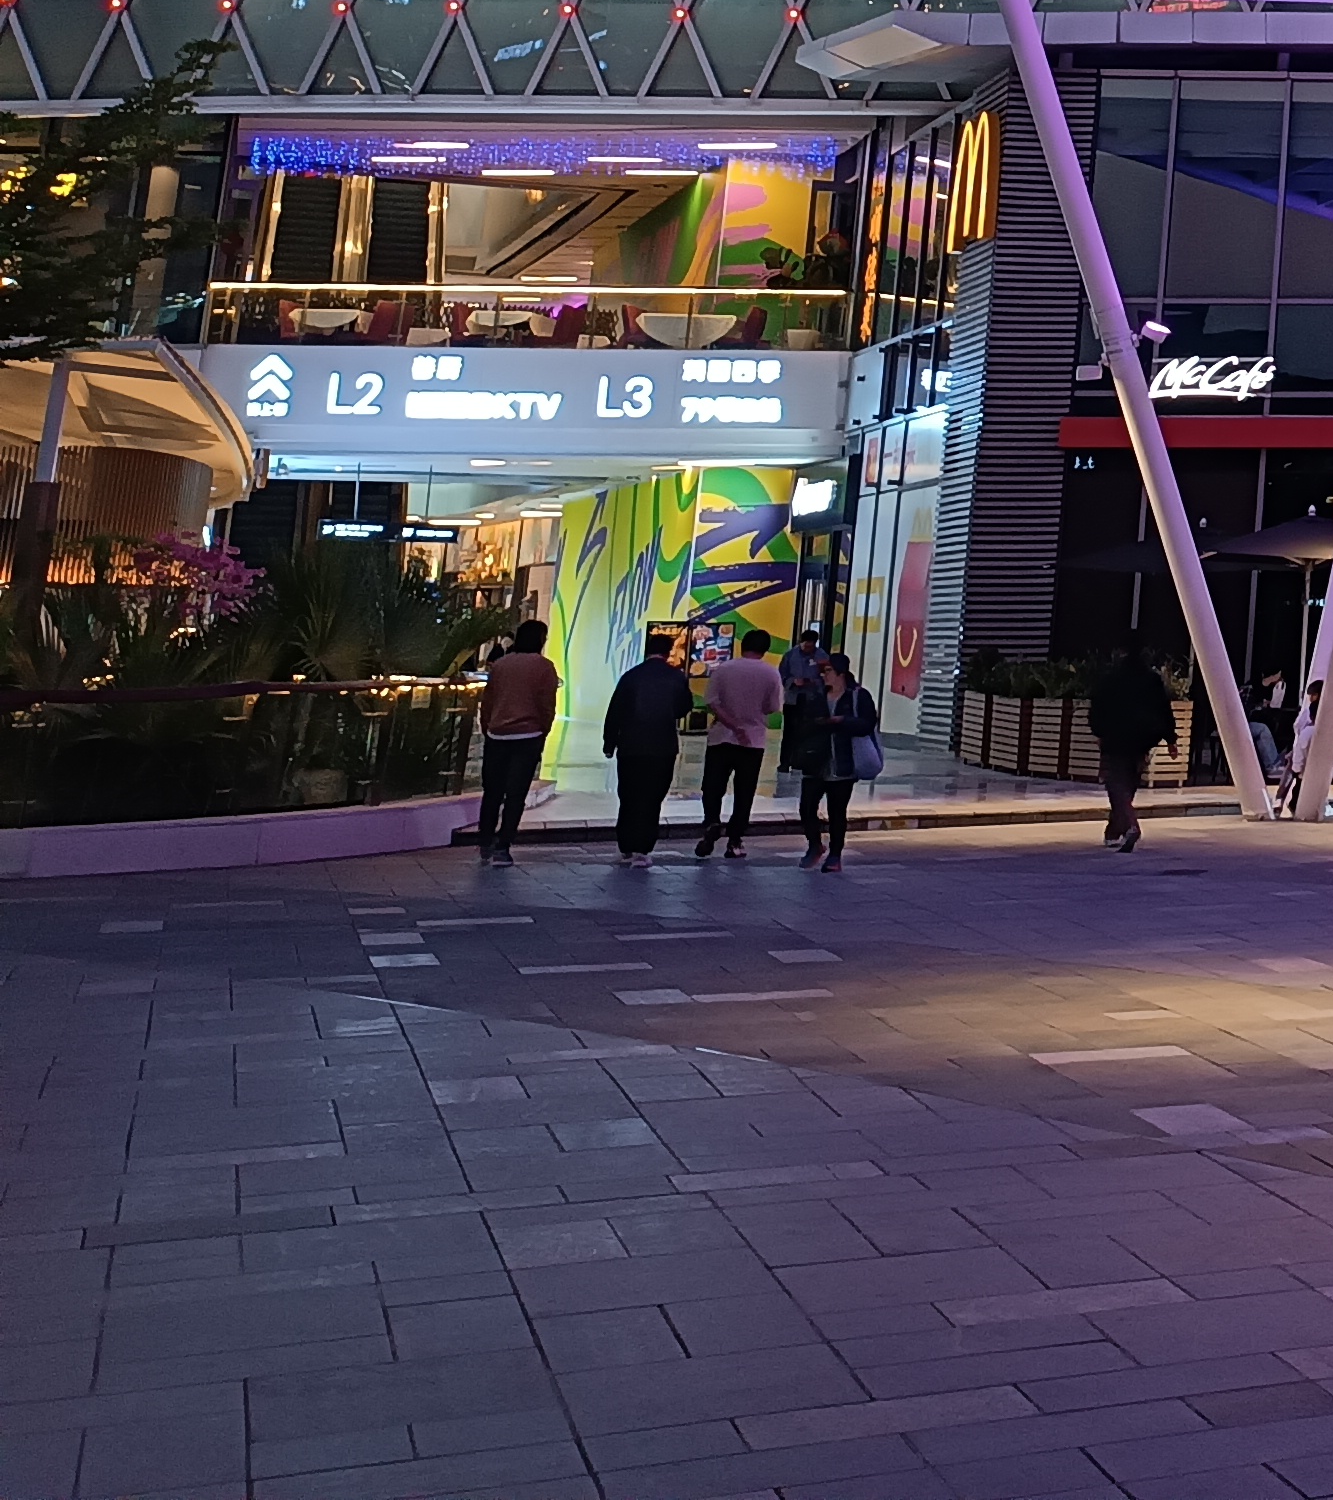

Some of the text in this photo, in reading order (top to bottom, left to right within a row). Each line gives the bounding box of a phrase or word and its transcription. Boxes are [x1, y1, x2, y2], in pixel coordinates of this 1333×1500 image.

[326, 371, 384, 415] L2
[596, 375, 654, 418] L3
[1149, 355, 1277, 401] McCafé
